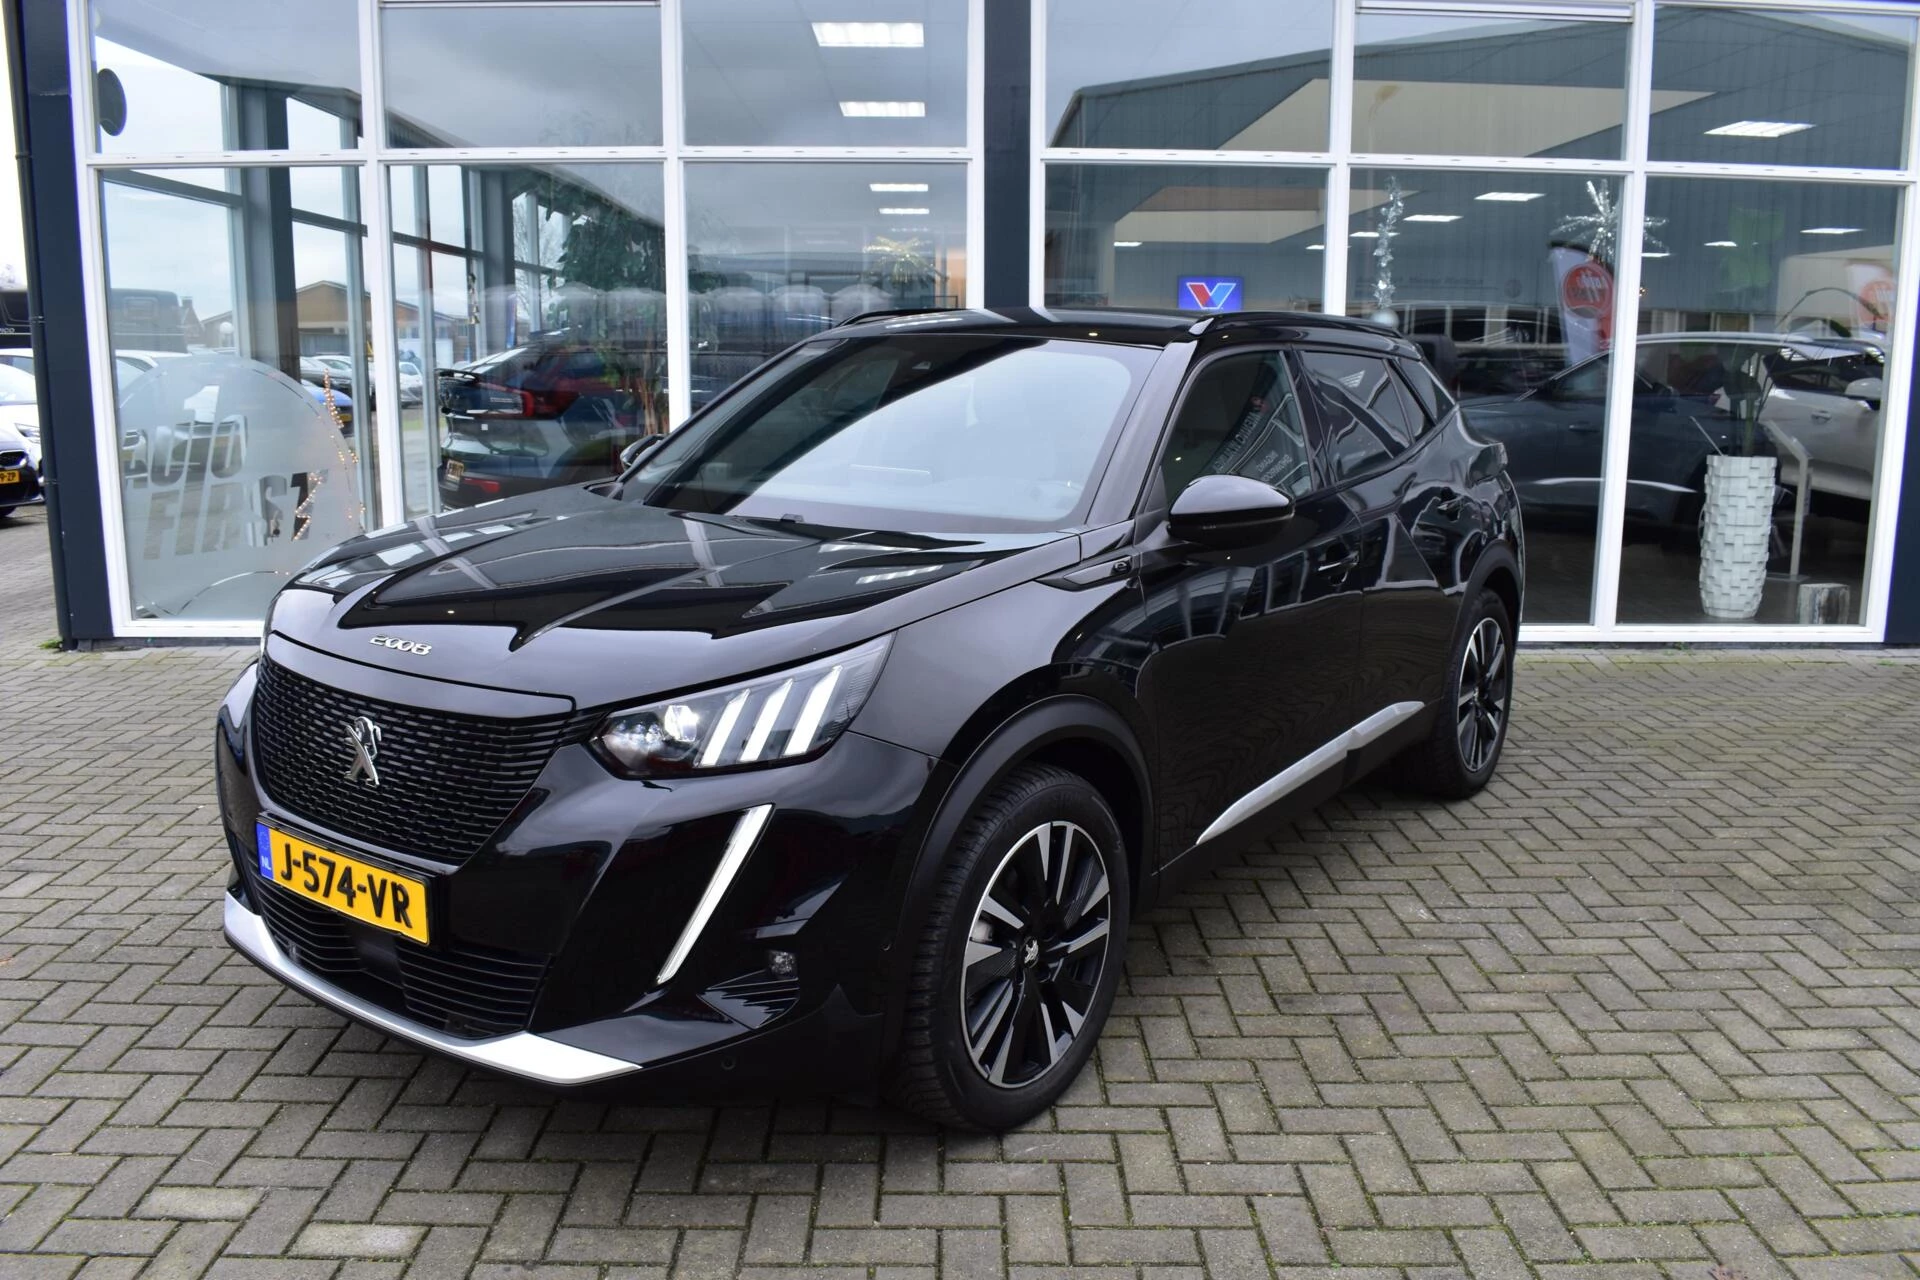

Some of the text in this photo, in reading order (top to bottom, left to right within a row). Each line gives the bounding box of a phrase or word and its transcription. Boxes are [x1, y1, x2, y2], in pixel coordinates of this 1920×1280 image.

[369, 634, 432, 655] 2008
[261, 843, 413, 929] NL J-574-VR
